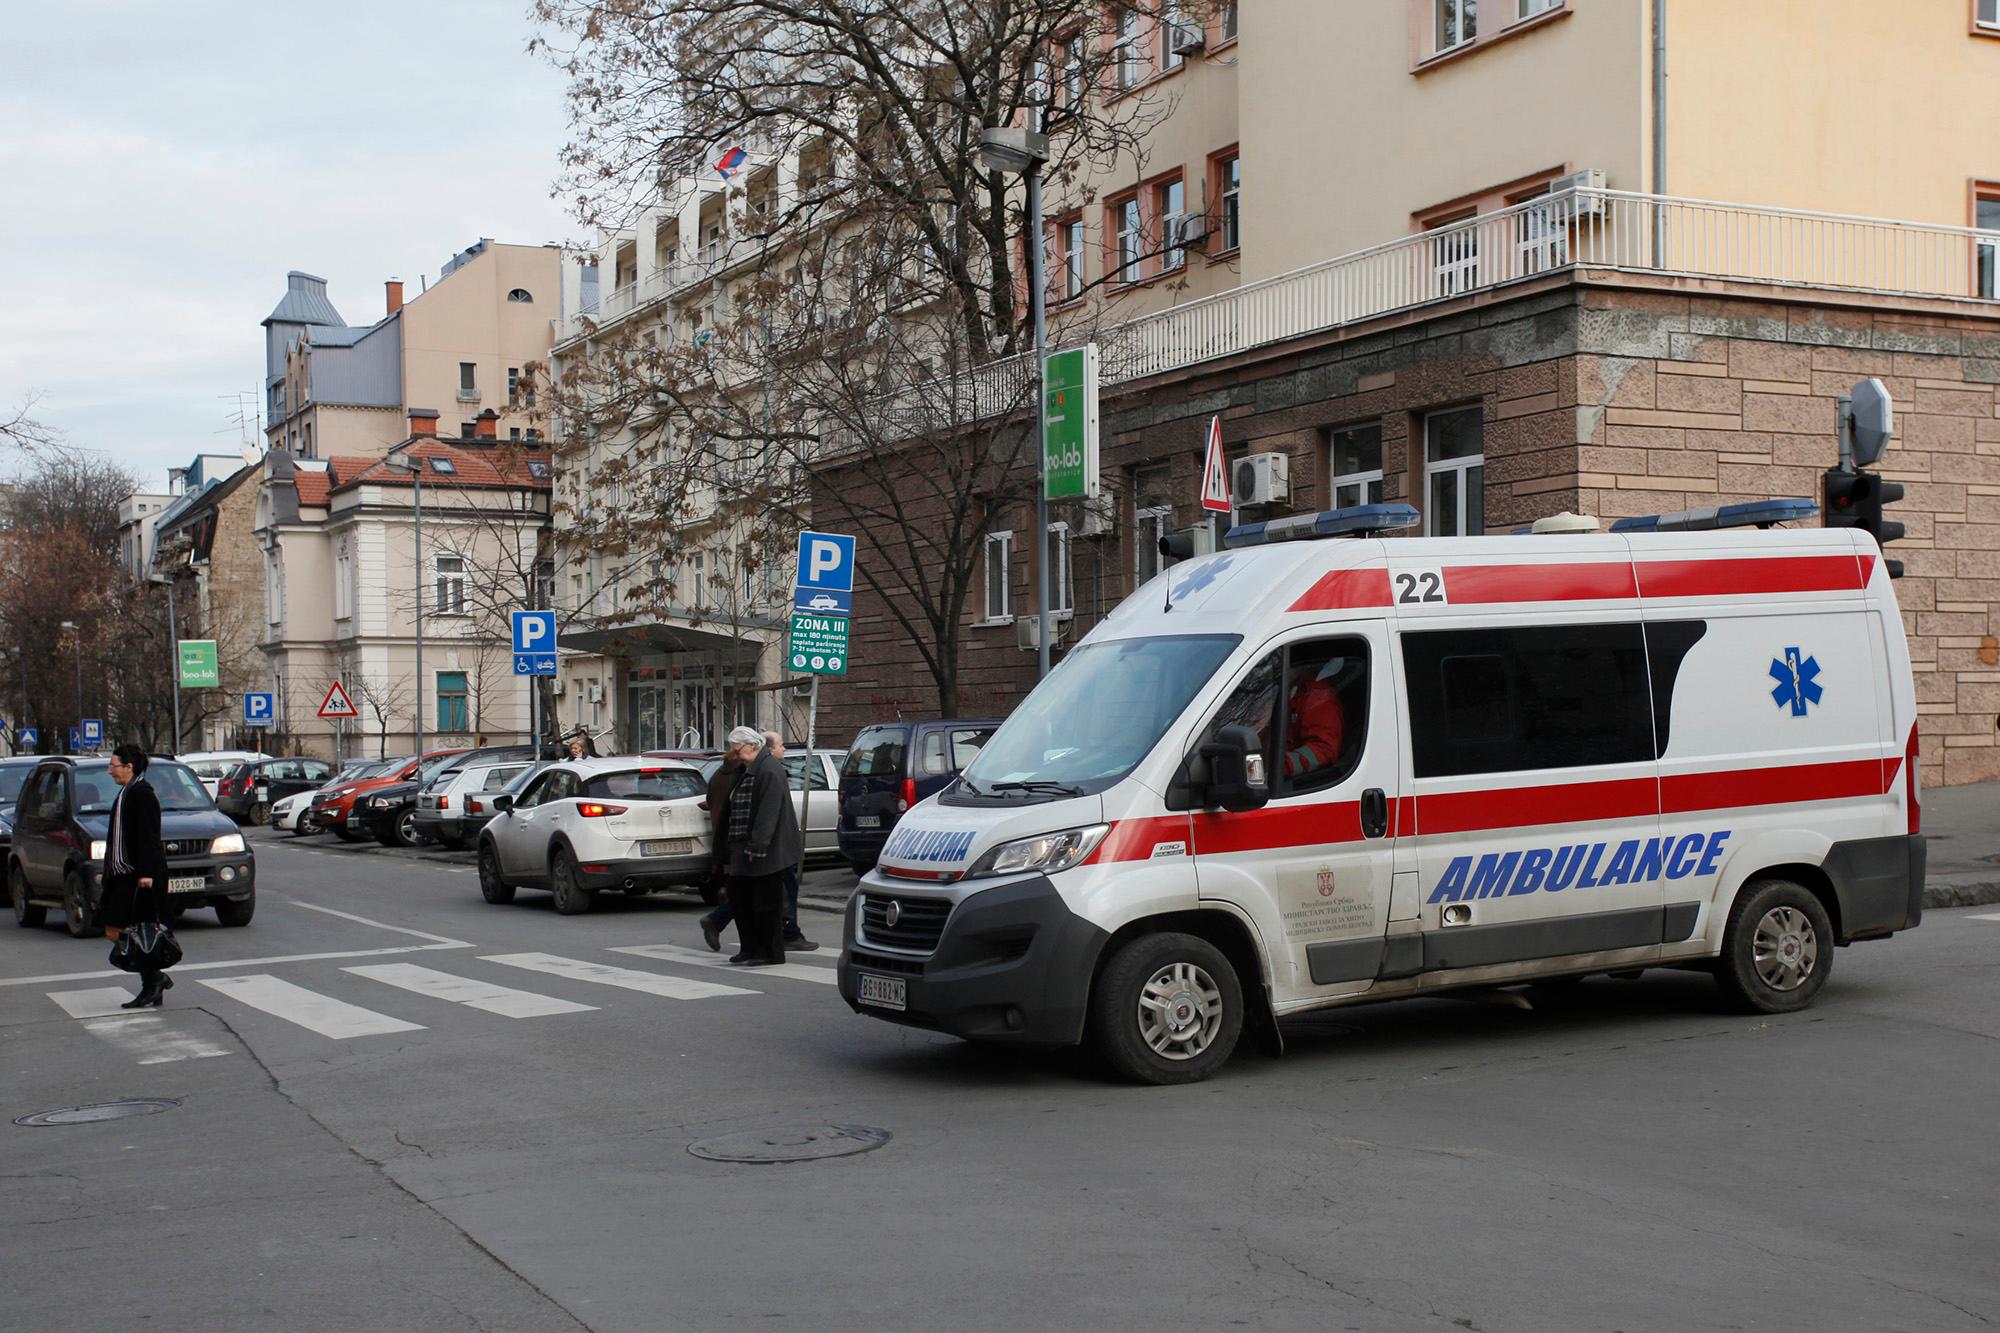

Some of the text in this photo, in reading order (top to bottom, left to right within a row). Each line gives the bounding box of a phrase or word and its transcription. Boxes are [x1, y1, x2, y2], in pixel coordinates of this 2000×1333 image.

[810, 540, 841, 582] P
[1395, 572, 1443, 604] 22
[522, 616, 546, 648] P
[795, 618, 845, 632] ZONA III
[250, 696, 267, 716] P
[1425, 830, 1732, 904] AMBULANCE
